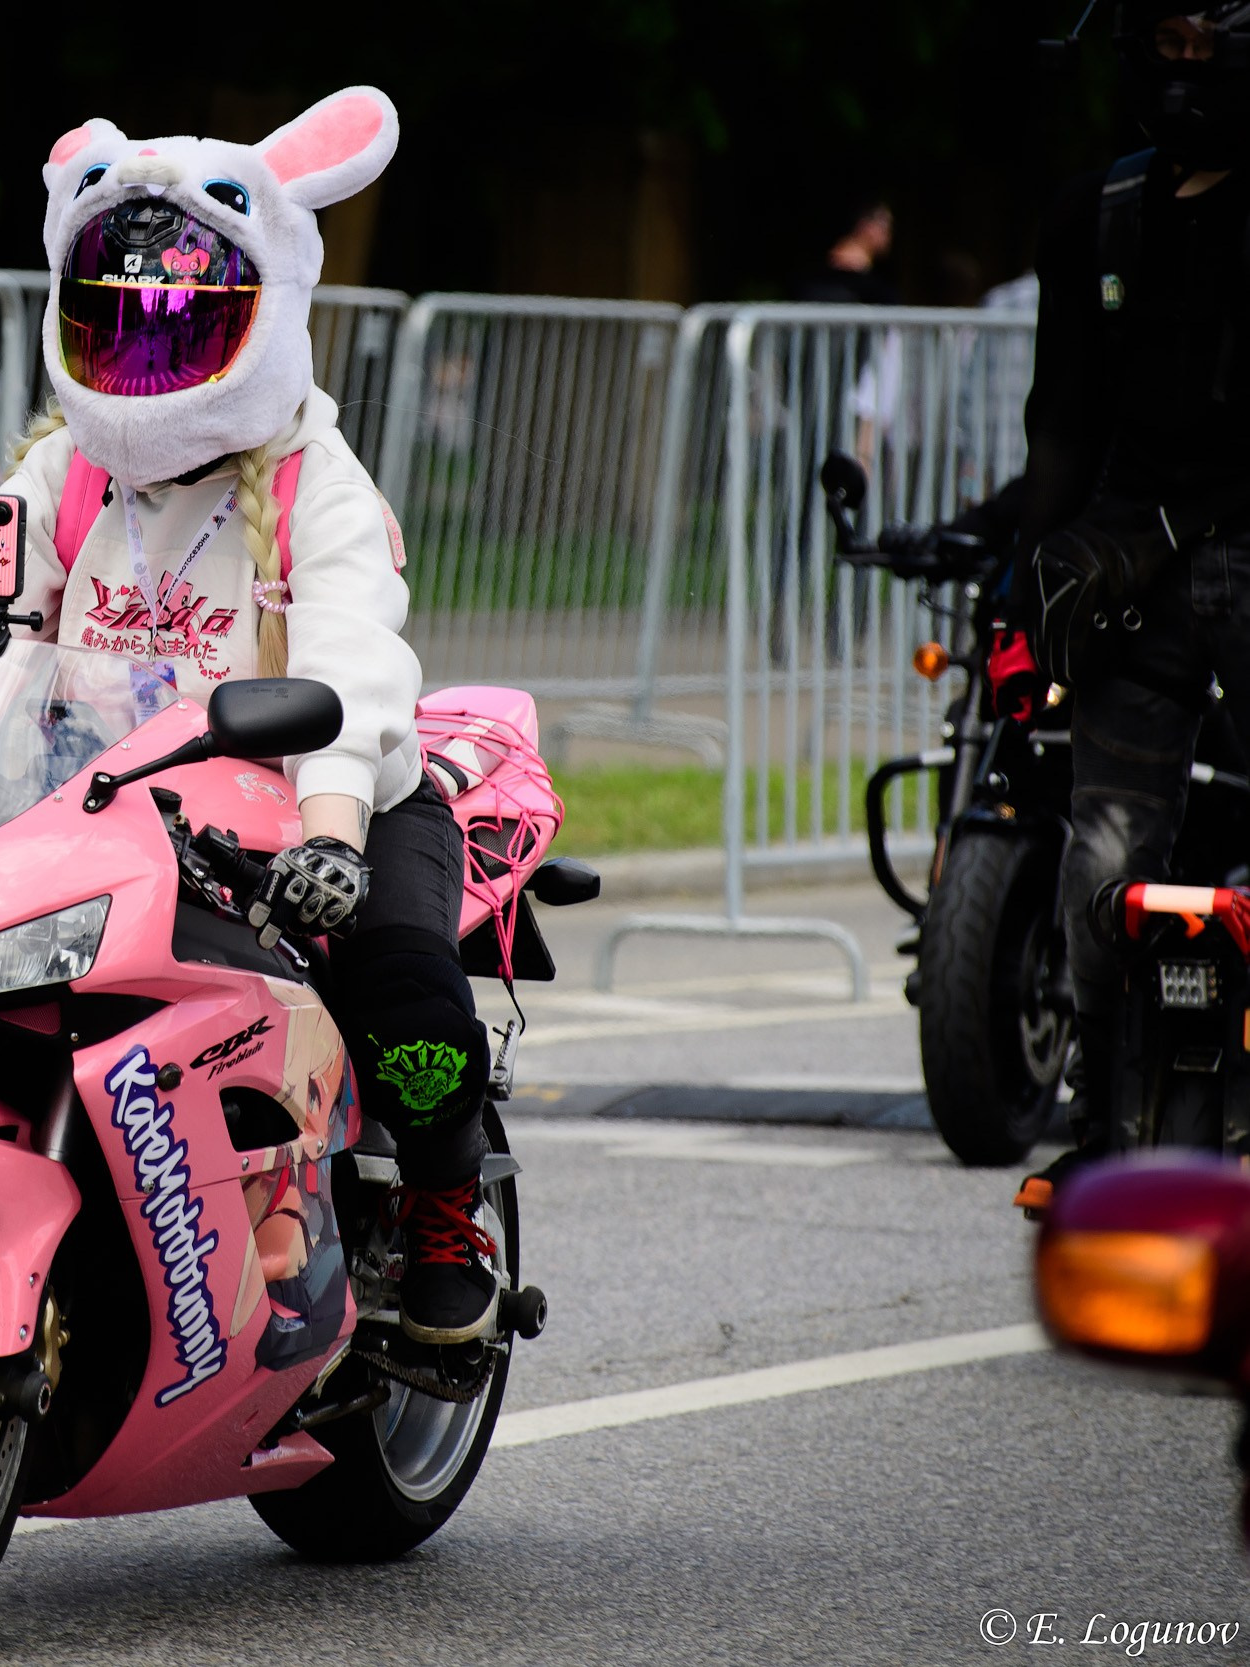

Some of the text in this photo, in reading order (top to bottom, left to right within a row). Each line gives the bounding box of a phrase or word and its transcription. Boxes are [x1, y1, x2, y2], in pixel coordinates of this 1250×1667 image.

[102, 274, 165, 284] SHARK
[178, 532, 211, 577] мотосезона
[189, 1015, 275, 1070] CBR
